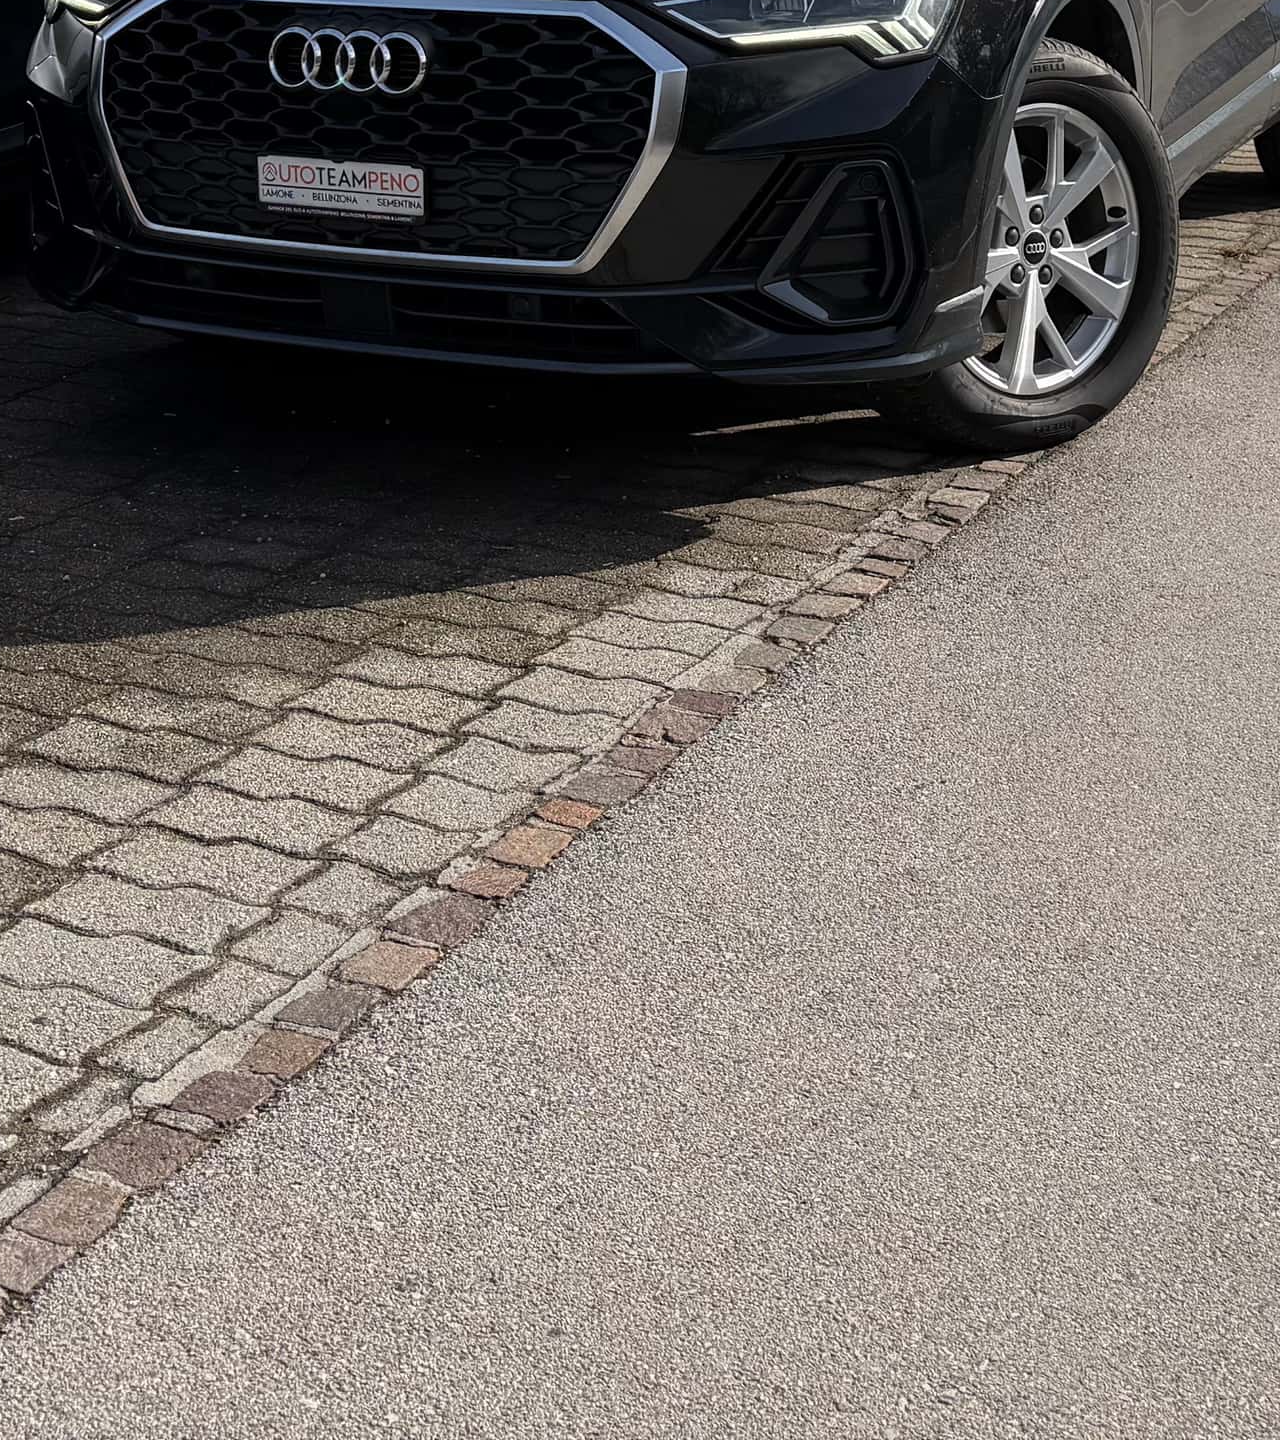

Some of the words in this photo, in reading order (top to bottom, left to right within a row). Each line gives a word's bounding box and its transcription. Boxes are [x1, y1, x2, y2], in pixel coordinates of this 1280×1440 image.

[262, 188, 296, 200] LAMONE
[312, 192, 358, 205] BELLINZONA
[376, 198, 423, 210] SEMENTINA
